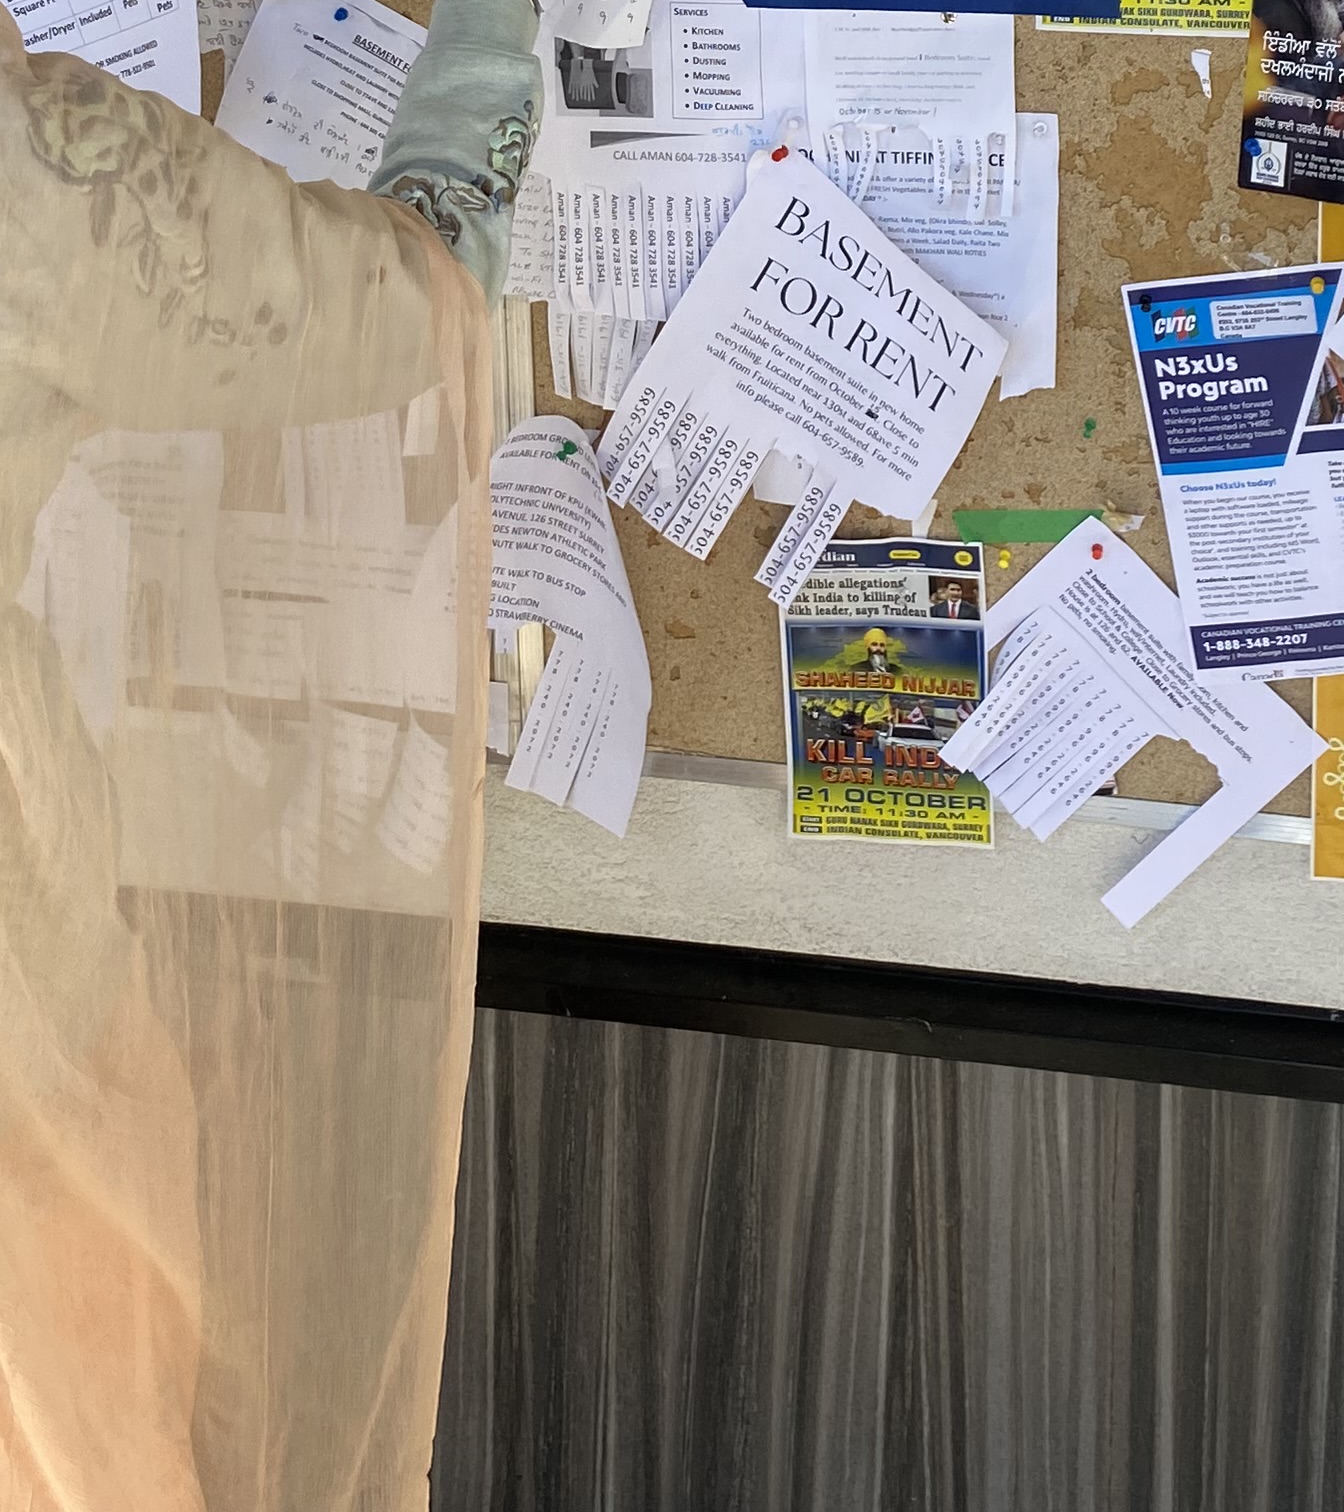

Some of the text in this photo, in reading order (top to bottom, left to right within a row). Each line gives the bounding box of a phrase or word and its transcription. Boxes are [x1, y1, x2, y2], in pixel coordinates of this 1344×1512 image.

[692, 27, 724, 36] KITCHEN
[1263, 30, 1311, 54] ਇੰਡੀਆ
[692, 42, 740, 51] BATHROOMS
[692, 57, 726, 66] DUSTING
[693, 72, 730, 81] MOPPING
[613, 150, 747, 164] CALL AMAN 604-728-3541
[775, 195, 984, 373] BASEMENT
[750, 256, 957, 413] FOR RENT
[1154, 315, 1197, 335] CVTC
[742, 307, 847, 381] Two bedroom basement
[1154, 353, 1238, 377] N3xUs
[1158, 376, 1268, 401] Program
[1203, 632, 1308, 652] 1-888-348-2207
[797, 786, 987, 810] 21 OCTOBER
